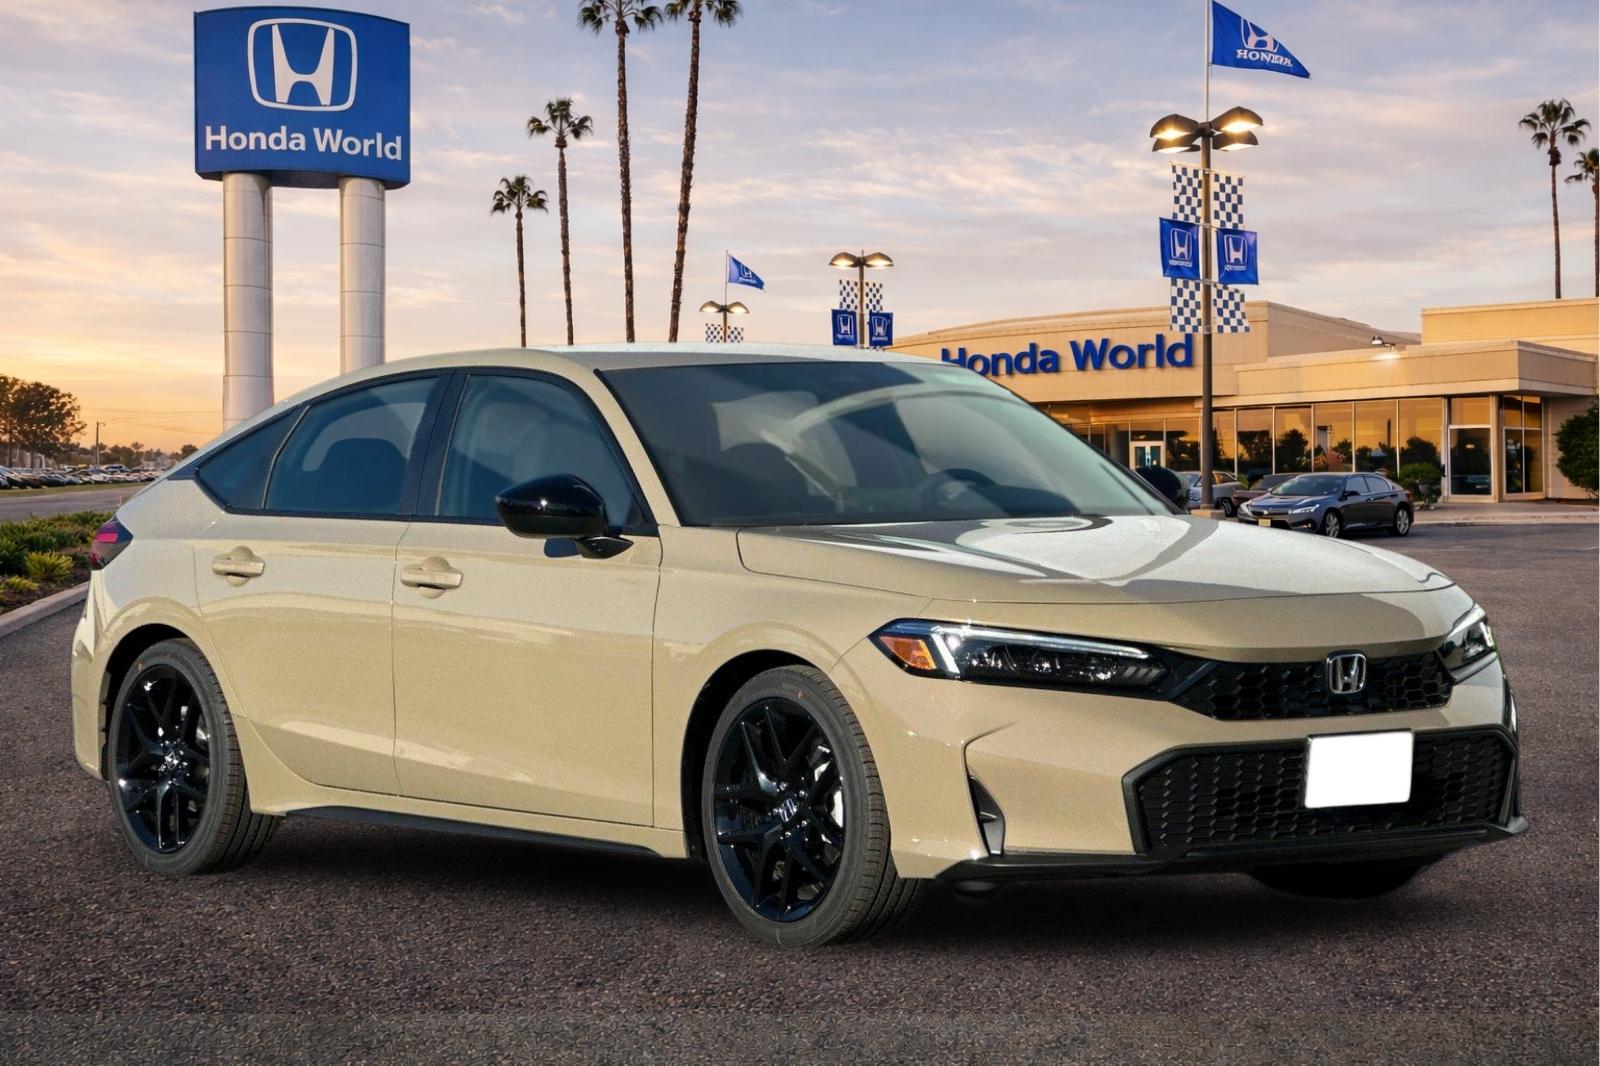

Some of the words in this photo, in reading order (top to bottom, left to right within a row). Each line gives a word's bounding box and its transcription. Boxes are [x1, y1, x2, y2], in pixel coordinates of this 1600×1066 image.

[205, 125, 306, 151] Honda
[313, 127, 402, 161] World
[941, 342, 1060, 376] Honda
[1069, 333, 1193, 371] World
